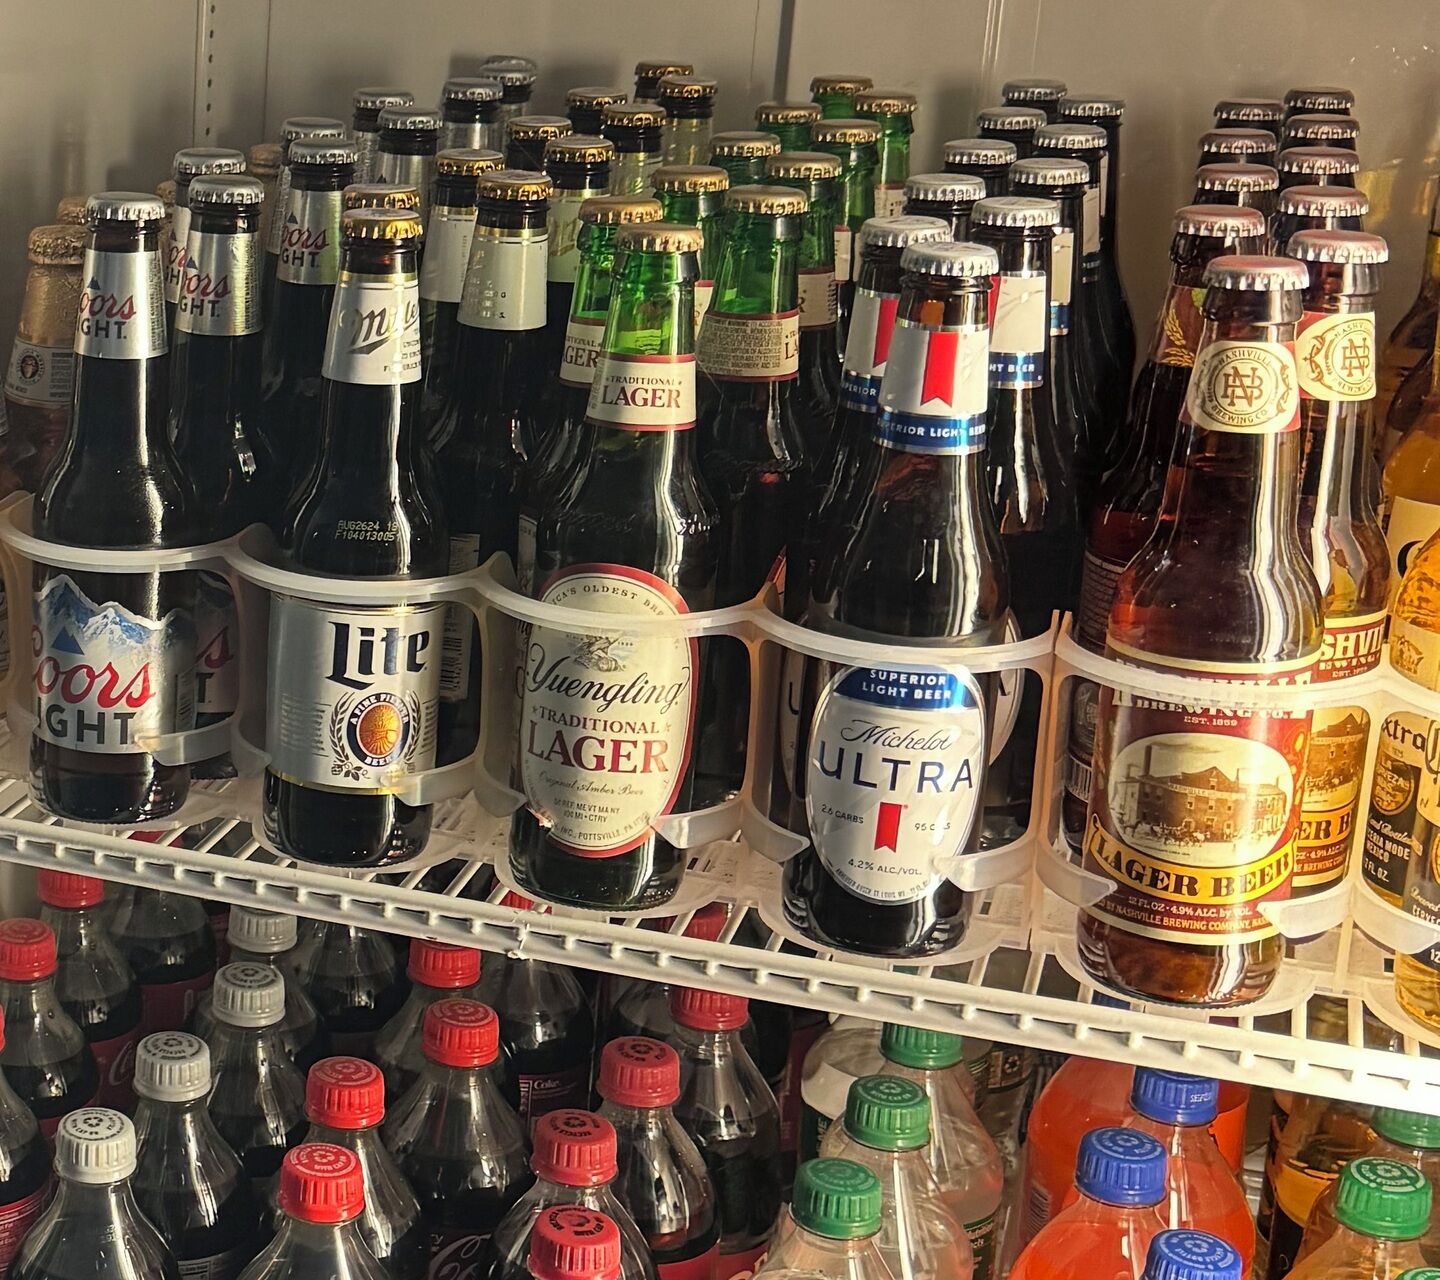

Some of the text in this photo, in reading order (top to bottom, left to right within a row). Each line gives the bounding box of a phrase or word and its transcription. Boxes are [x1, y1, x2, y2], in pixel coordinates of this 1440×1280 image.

[611, 375, 674, 387] TRADITIONAL
[601, 386, 682, 410] LAGER
[930, 427, 964, 438] LIGHT
[583, 584, 639, 600] OLDEST
[326, 620, 430, 690] Lite
[526, 643, 691, 715] Yuengling
[870, 669, 947, 686] SUPERIOR
[862, 681, 952, 701] LIGHT BEER
[539, 705, 660, 734] TRADITIONAL
[527, 719, 669, 774] LAGER
[819, 740, 974, 794] ULTRA
[577, 781, 617, 795] Amber
[821, 803, 864, 825] 2.6 CARBS
[914, 821, 927, 832] 95
[848, 857, 874, 872] 4.2%
[1097, 835, 1292, 898] LAGER BEER
[1115, 903, 1161, 925] NASHVILLE
[1162, 916, 1208, 931] BREWING
[1194, 907, 1218, 918] ALC.
